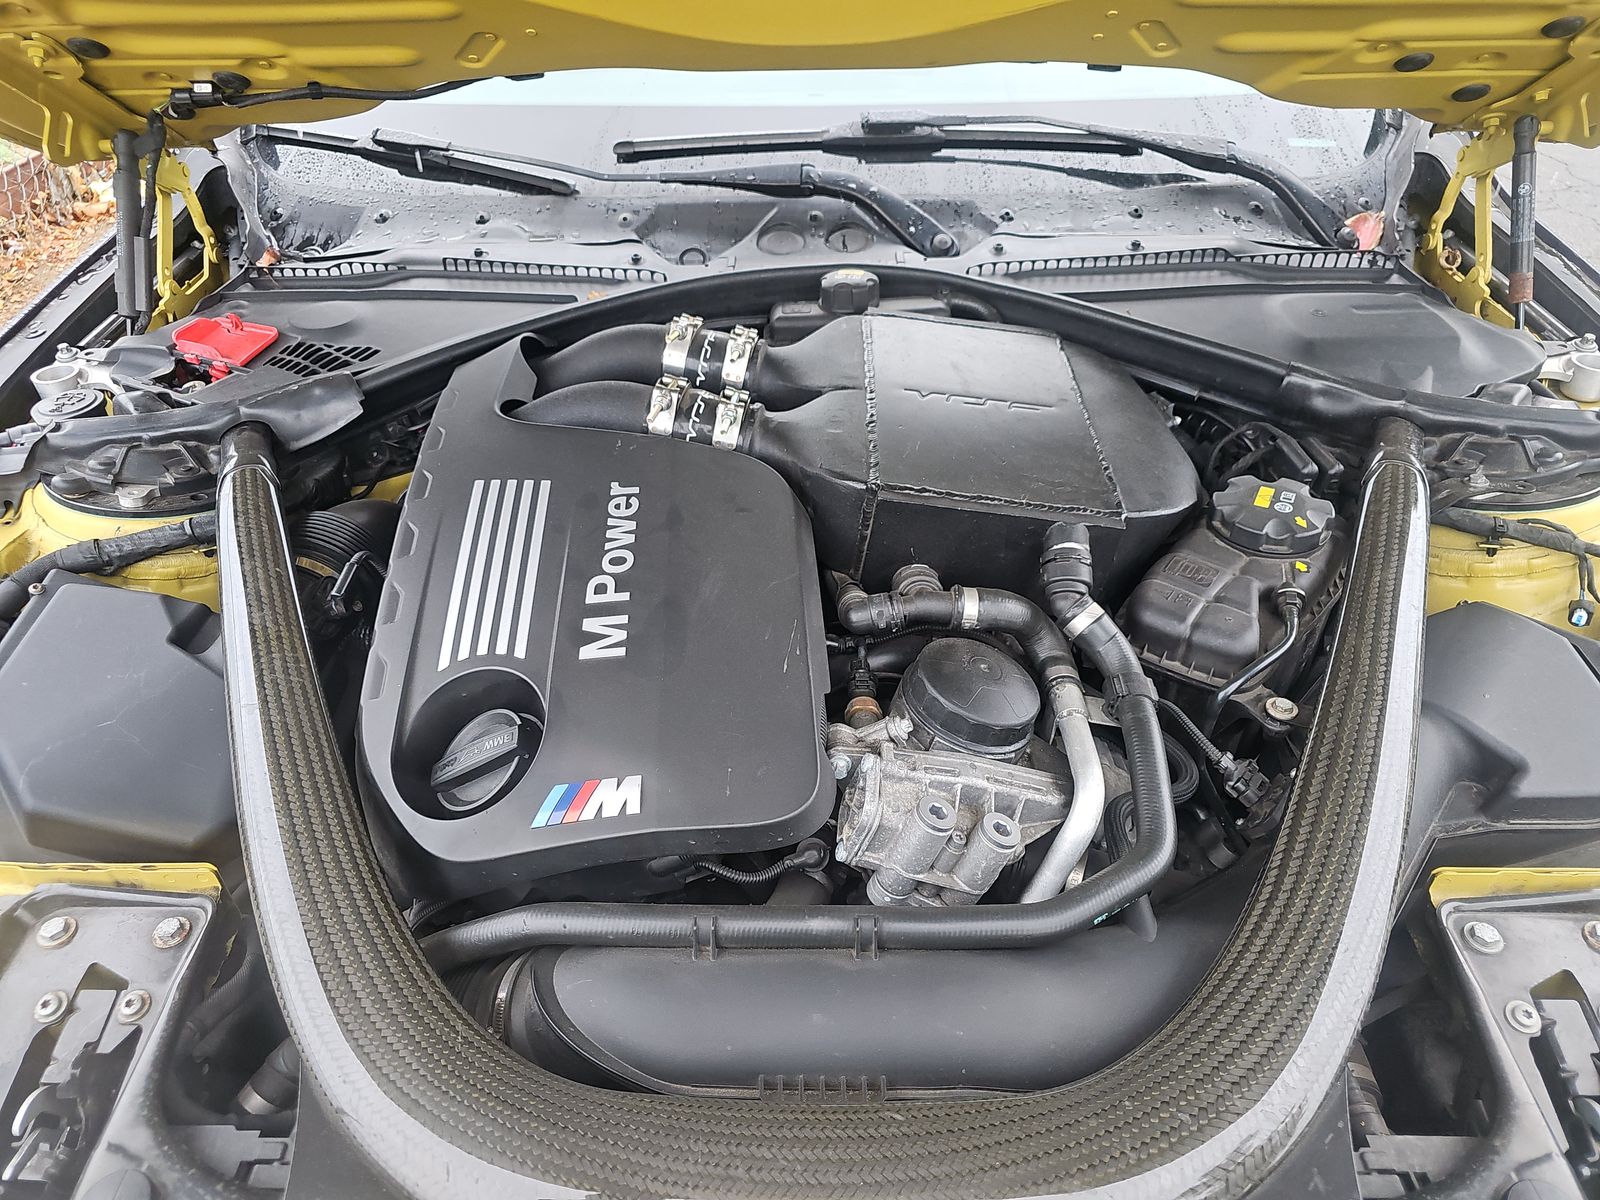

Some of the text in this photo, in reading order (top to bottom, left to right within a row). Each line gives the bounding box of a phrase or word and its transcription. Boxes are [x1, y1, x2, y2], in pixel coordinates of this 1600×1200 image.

[578, 481, 640, 660] M Power
[483, 733, 512, 751] BMW
